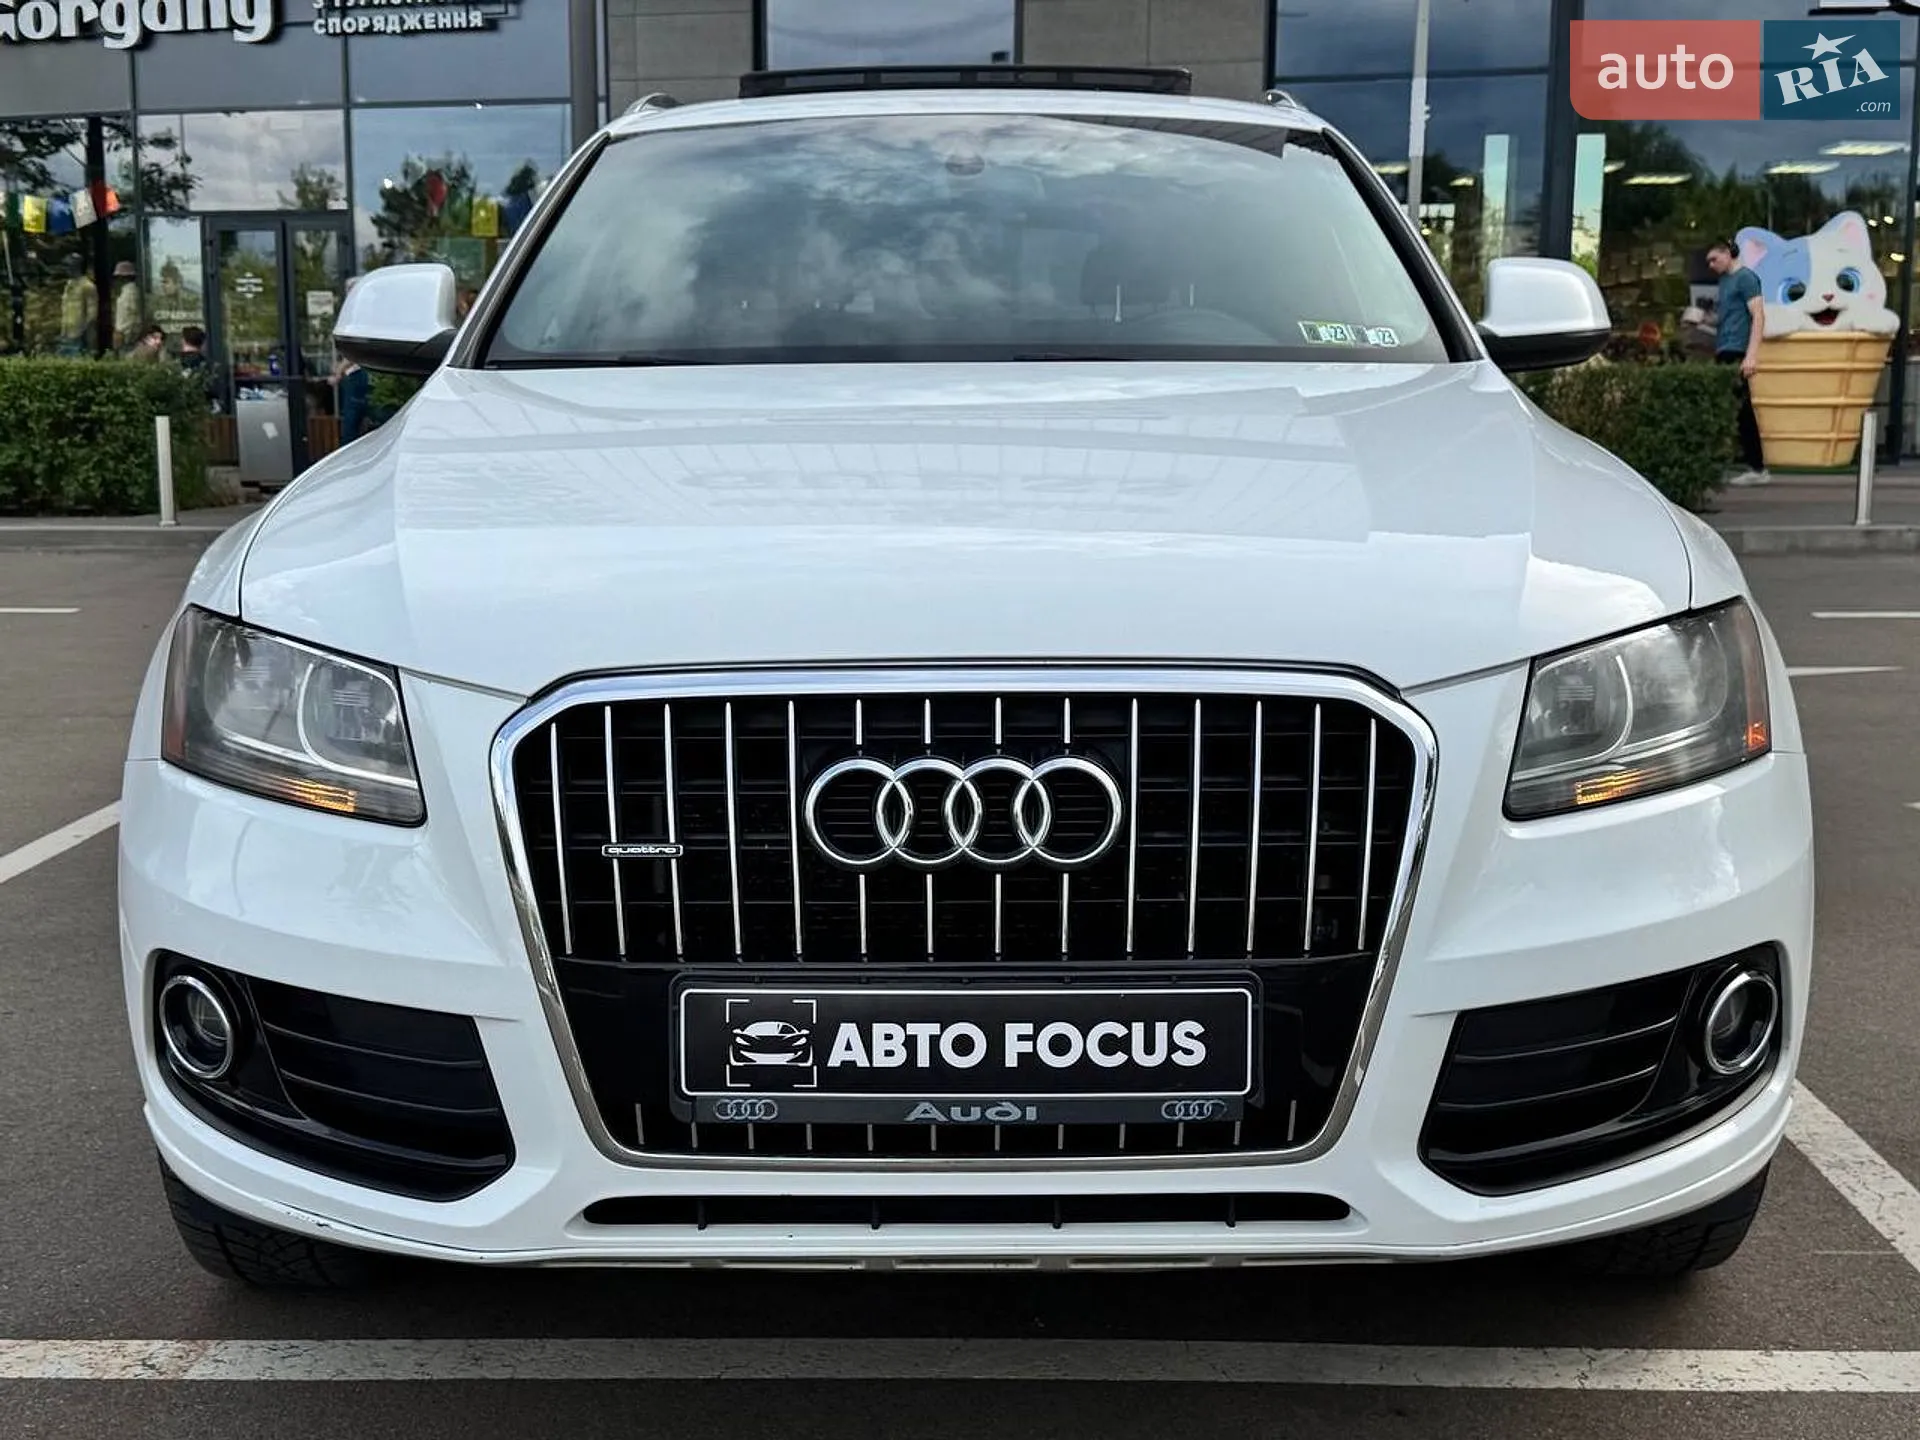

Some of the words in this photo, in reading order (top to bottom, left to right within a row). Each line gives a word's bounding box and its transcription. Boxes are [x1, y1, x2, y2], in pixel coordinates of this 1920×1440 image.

[313, 10, 484, 34] СПОРЯДЖЕННЯ
[608, 846, 677, 856] quattro
[1004, 1020, 1207, 1068] FOCUS
[903, 1101, 1038, 1122] Audi
